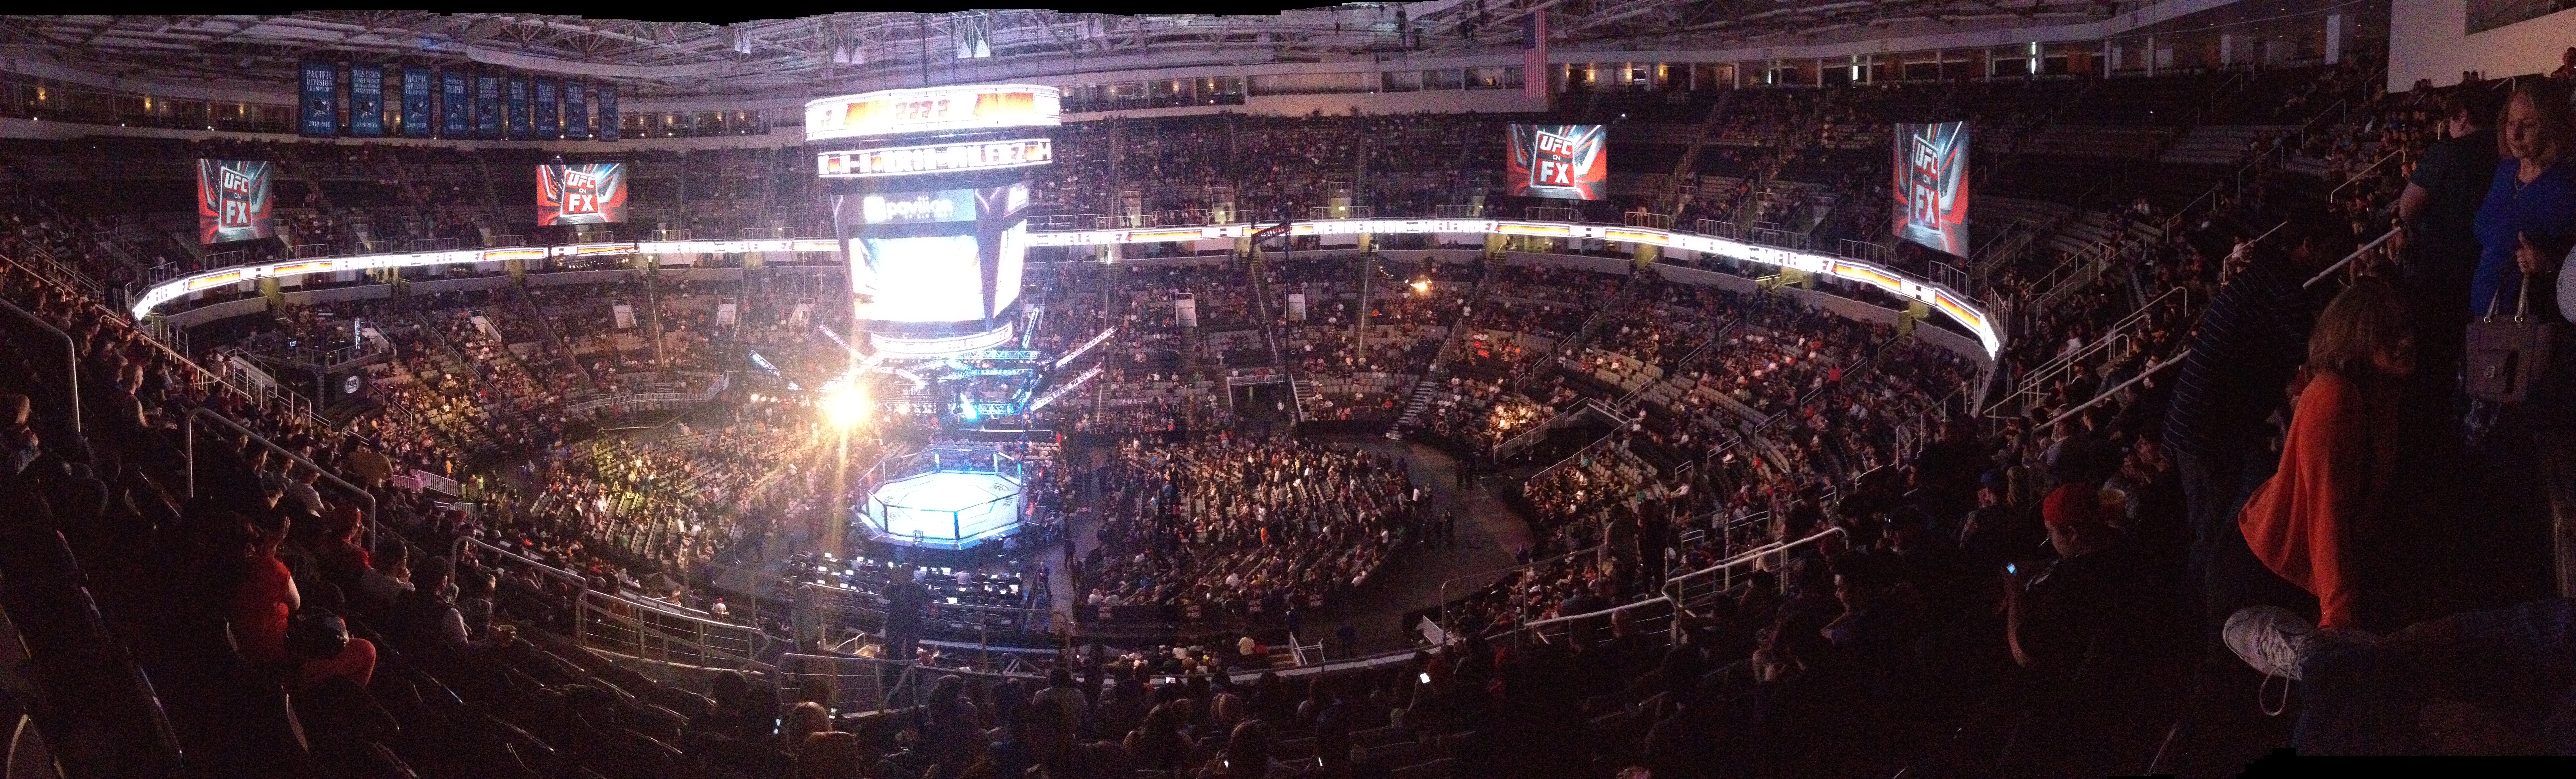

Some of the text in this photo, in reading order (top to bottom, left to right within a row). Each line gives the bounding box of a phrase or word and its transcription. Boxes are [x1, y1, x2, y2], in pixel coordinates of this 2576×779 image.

[306, 70, 333, 80] PACIFIC
[1540, 136, 1573, 156] UFC
[1915, 143, 1938, 175] UFC
[224, 172, 248, 192] UFC
[567, 174, 595, 188] UFC
[1541, 161, 1570, 184] FX
[226, 200, 247, 224] FX
[569, 194, 594, 212] FX
[887, 196, 953, 219] pavilion
[1915, 184, 1936, 224] FX
[1420, 220, 1498, 233] MELENDEZ
[347, 379, 357, 387] FOX
